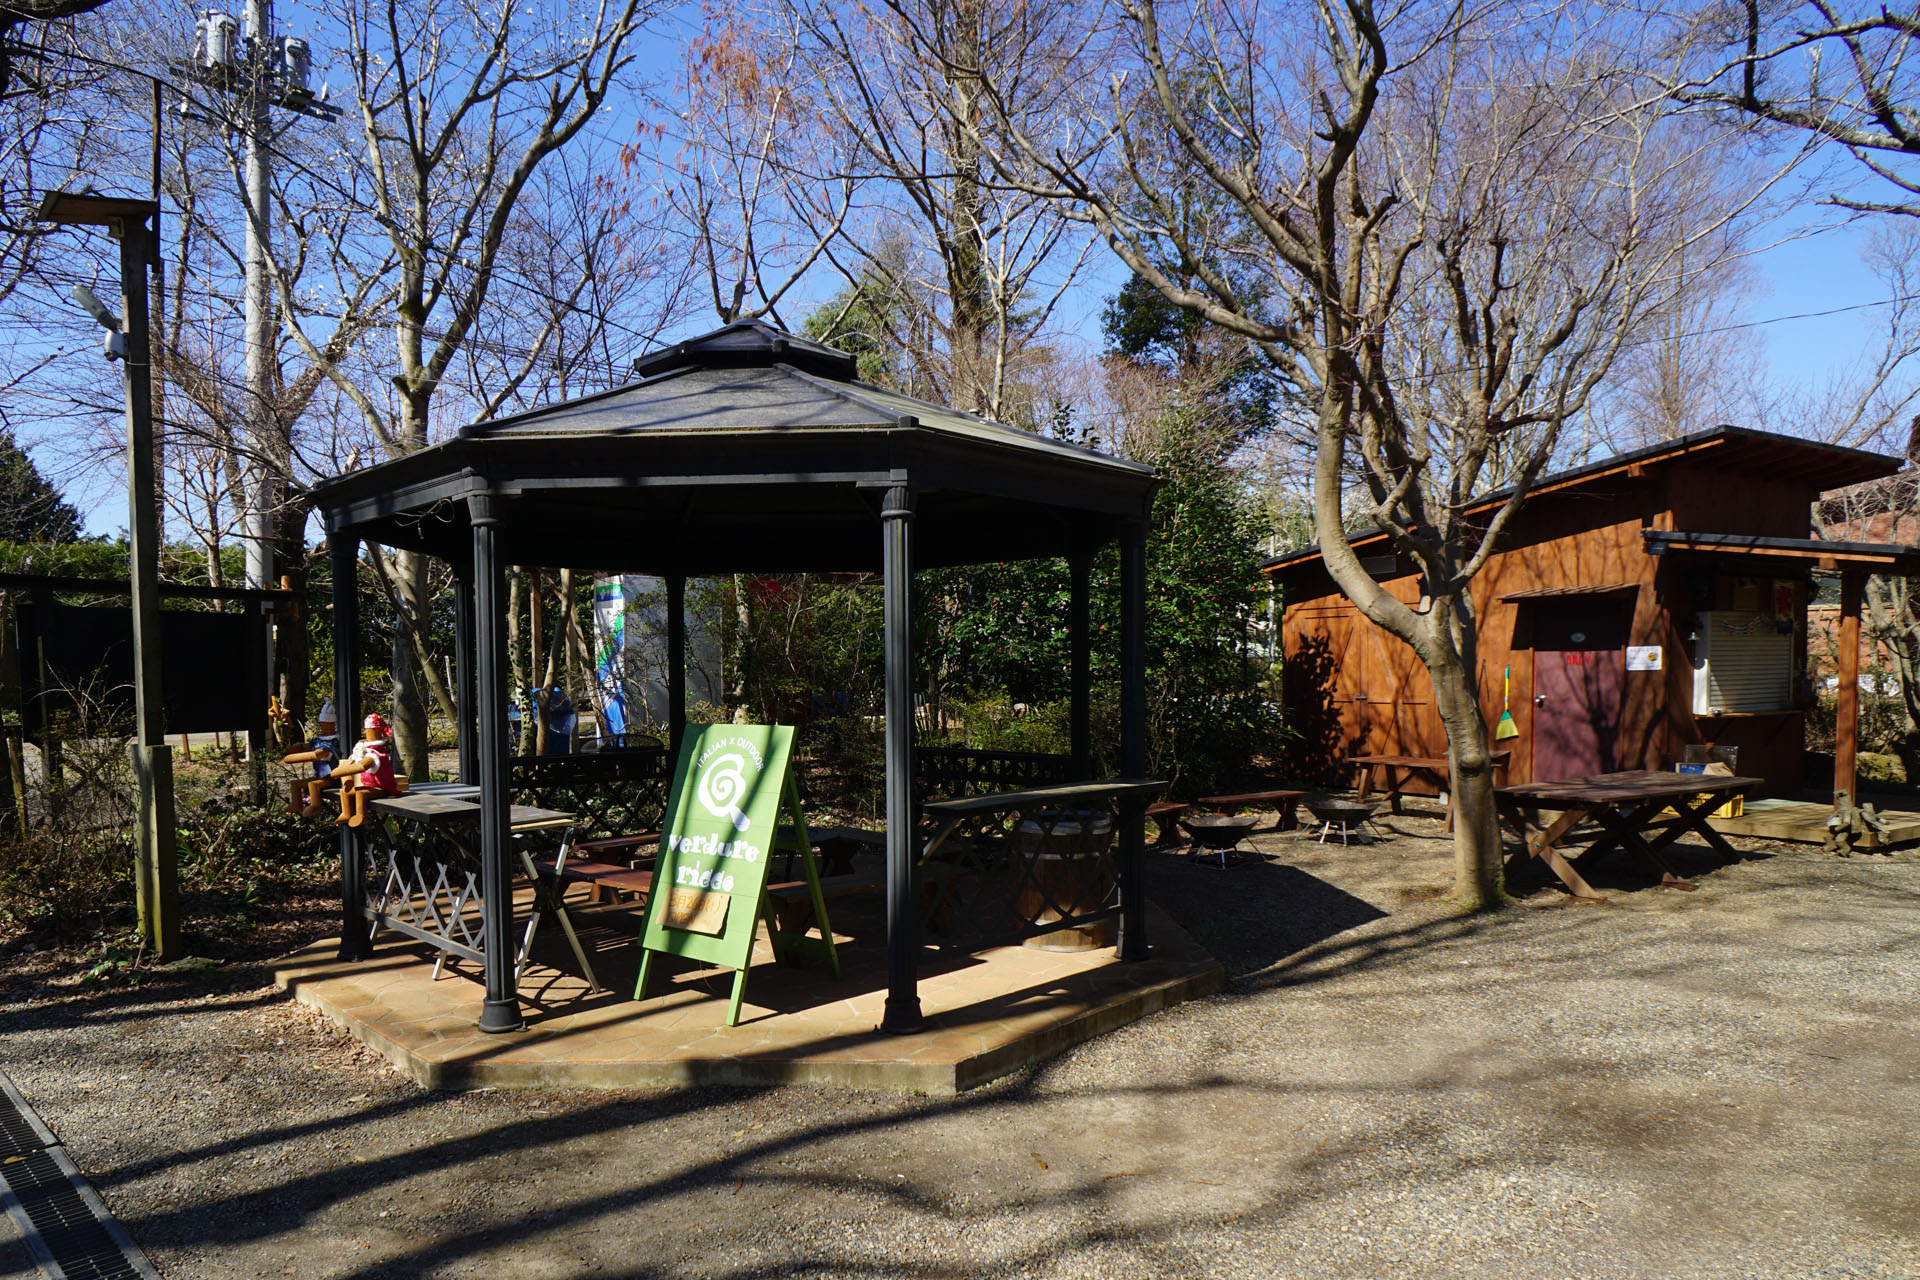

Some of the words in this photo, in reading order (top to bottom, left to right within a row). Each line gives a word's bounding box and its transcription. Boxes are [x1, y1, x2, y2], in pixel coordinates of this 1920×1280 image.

[1566, 655, 1592, 666] ONLY
[696, 737, 727, 768] ITALIAN
[736, 736, 764, 772] OUTDOOR
[669, 832, 760, 863] verdure
[676, 858, 734, 892] ricco
